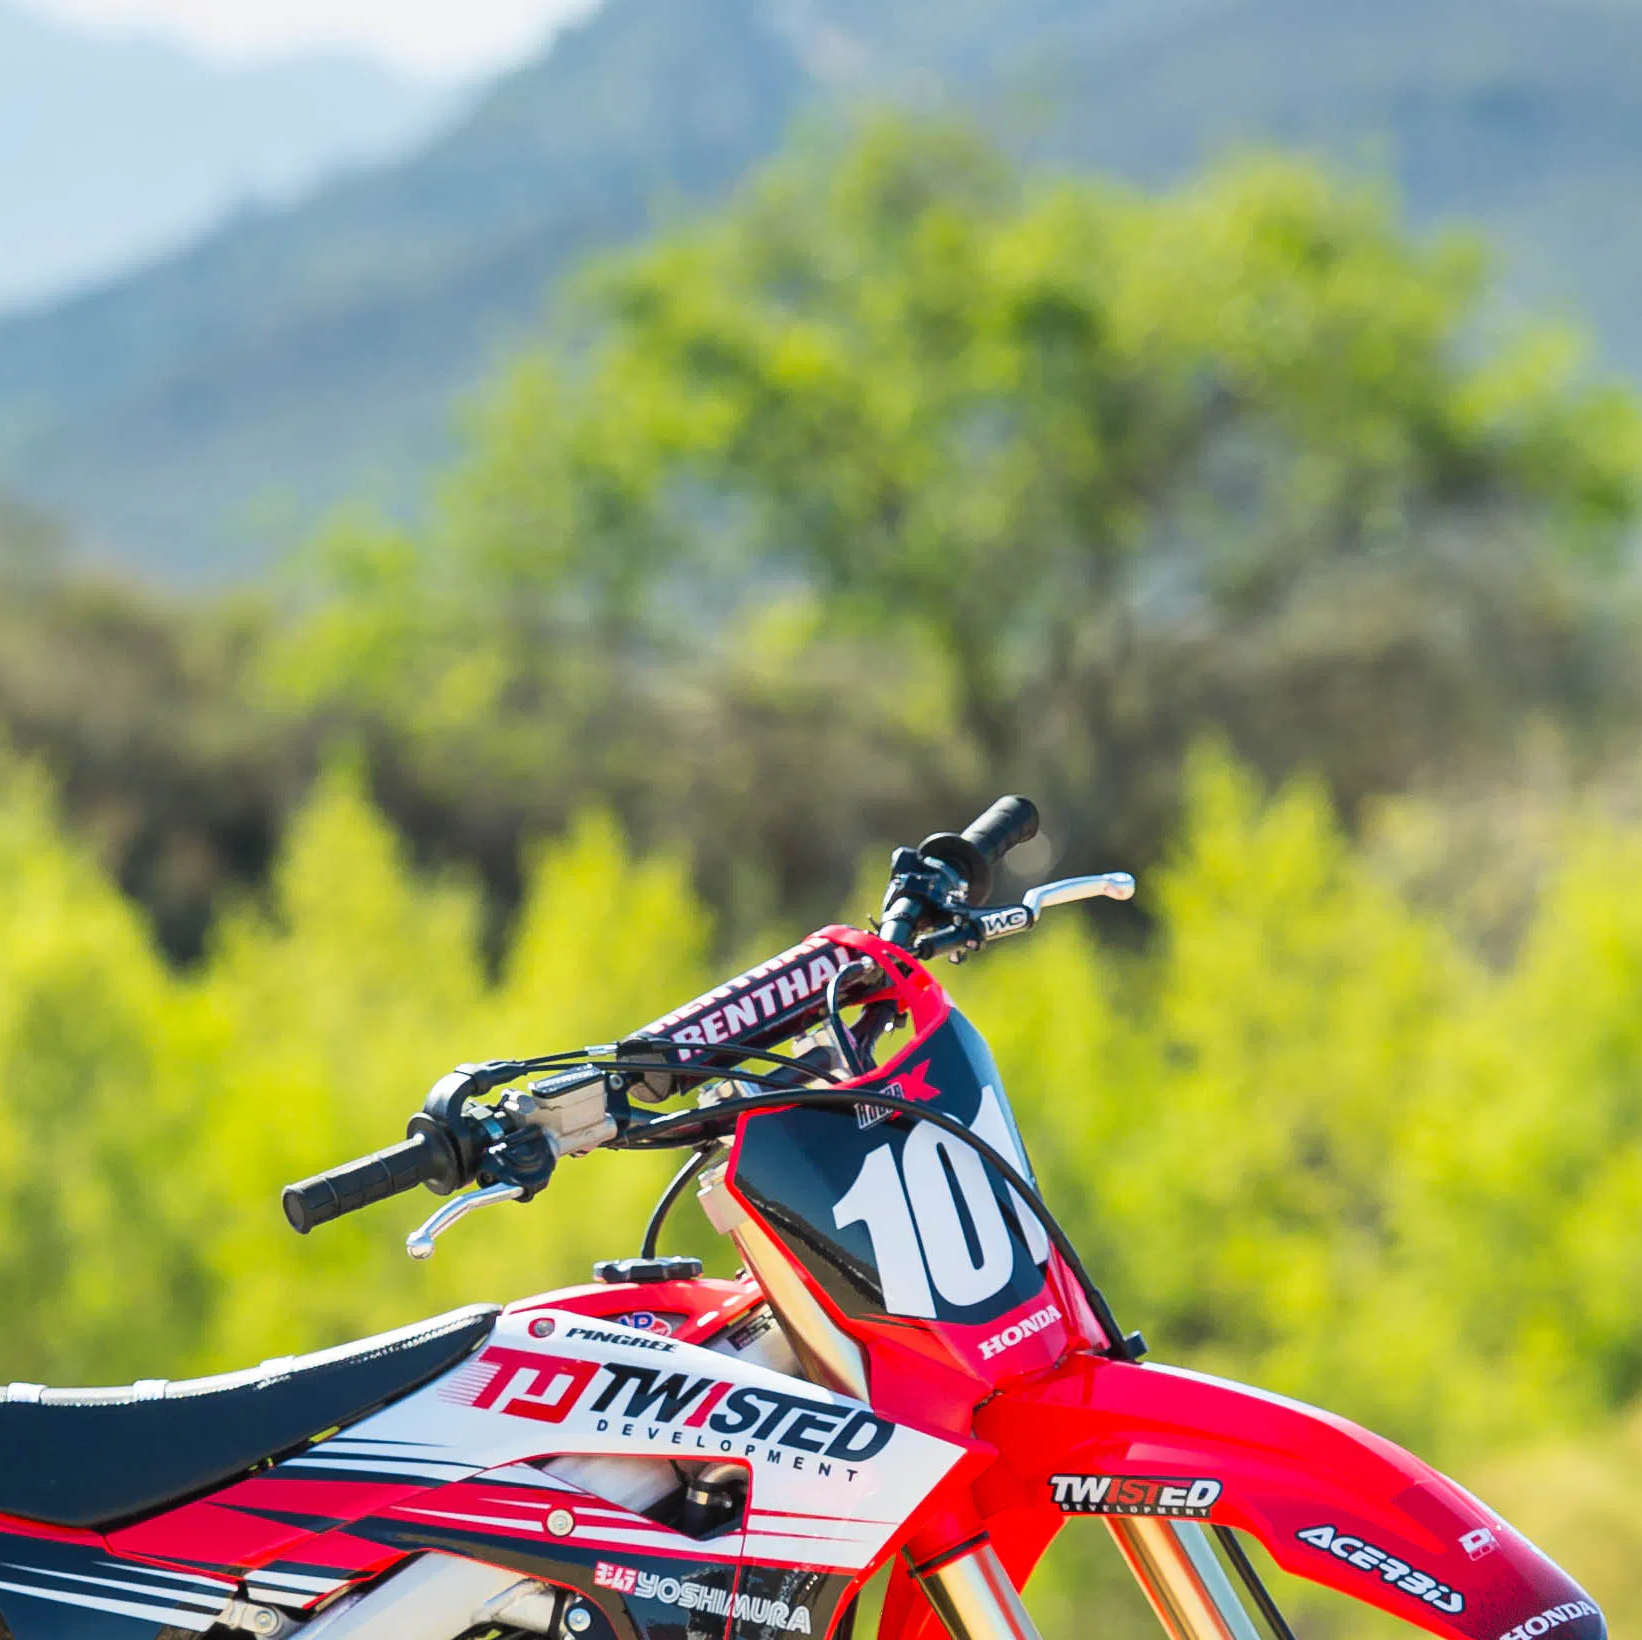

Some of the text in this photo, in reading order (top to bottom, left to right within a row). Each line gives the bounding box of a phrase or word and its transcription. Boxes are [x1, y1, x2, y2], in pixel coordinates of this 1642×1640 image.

[832, 1085, 1050, 1319] 101
[565, 1327, 679, 1353] PINGREE
[978, 1305, 1062, 1360] HONDA
[597, 1419, 860, 1483] DEVELOPMENT
[1051, 1476, 1221, 1507] TWISTED
[1062, 1503, 1207, 1516] DEVELOPMENT
[635, 1572, 811, 1635] YOSHIMURA
